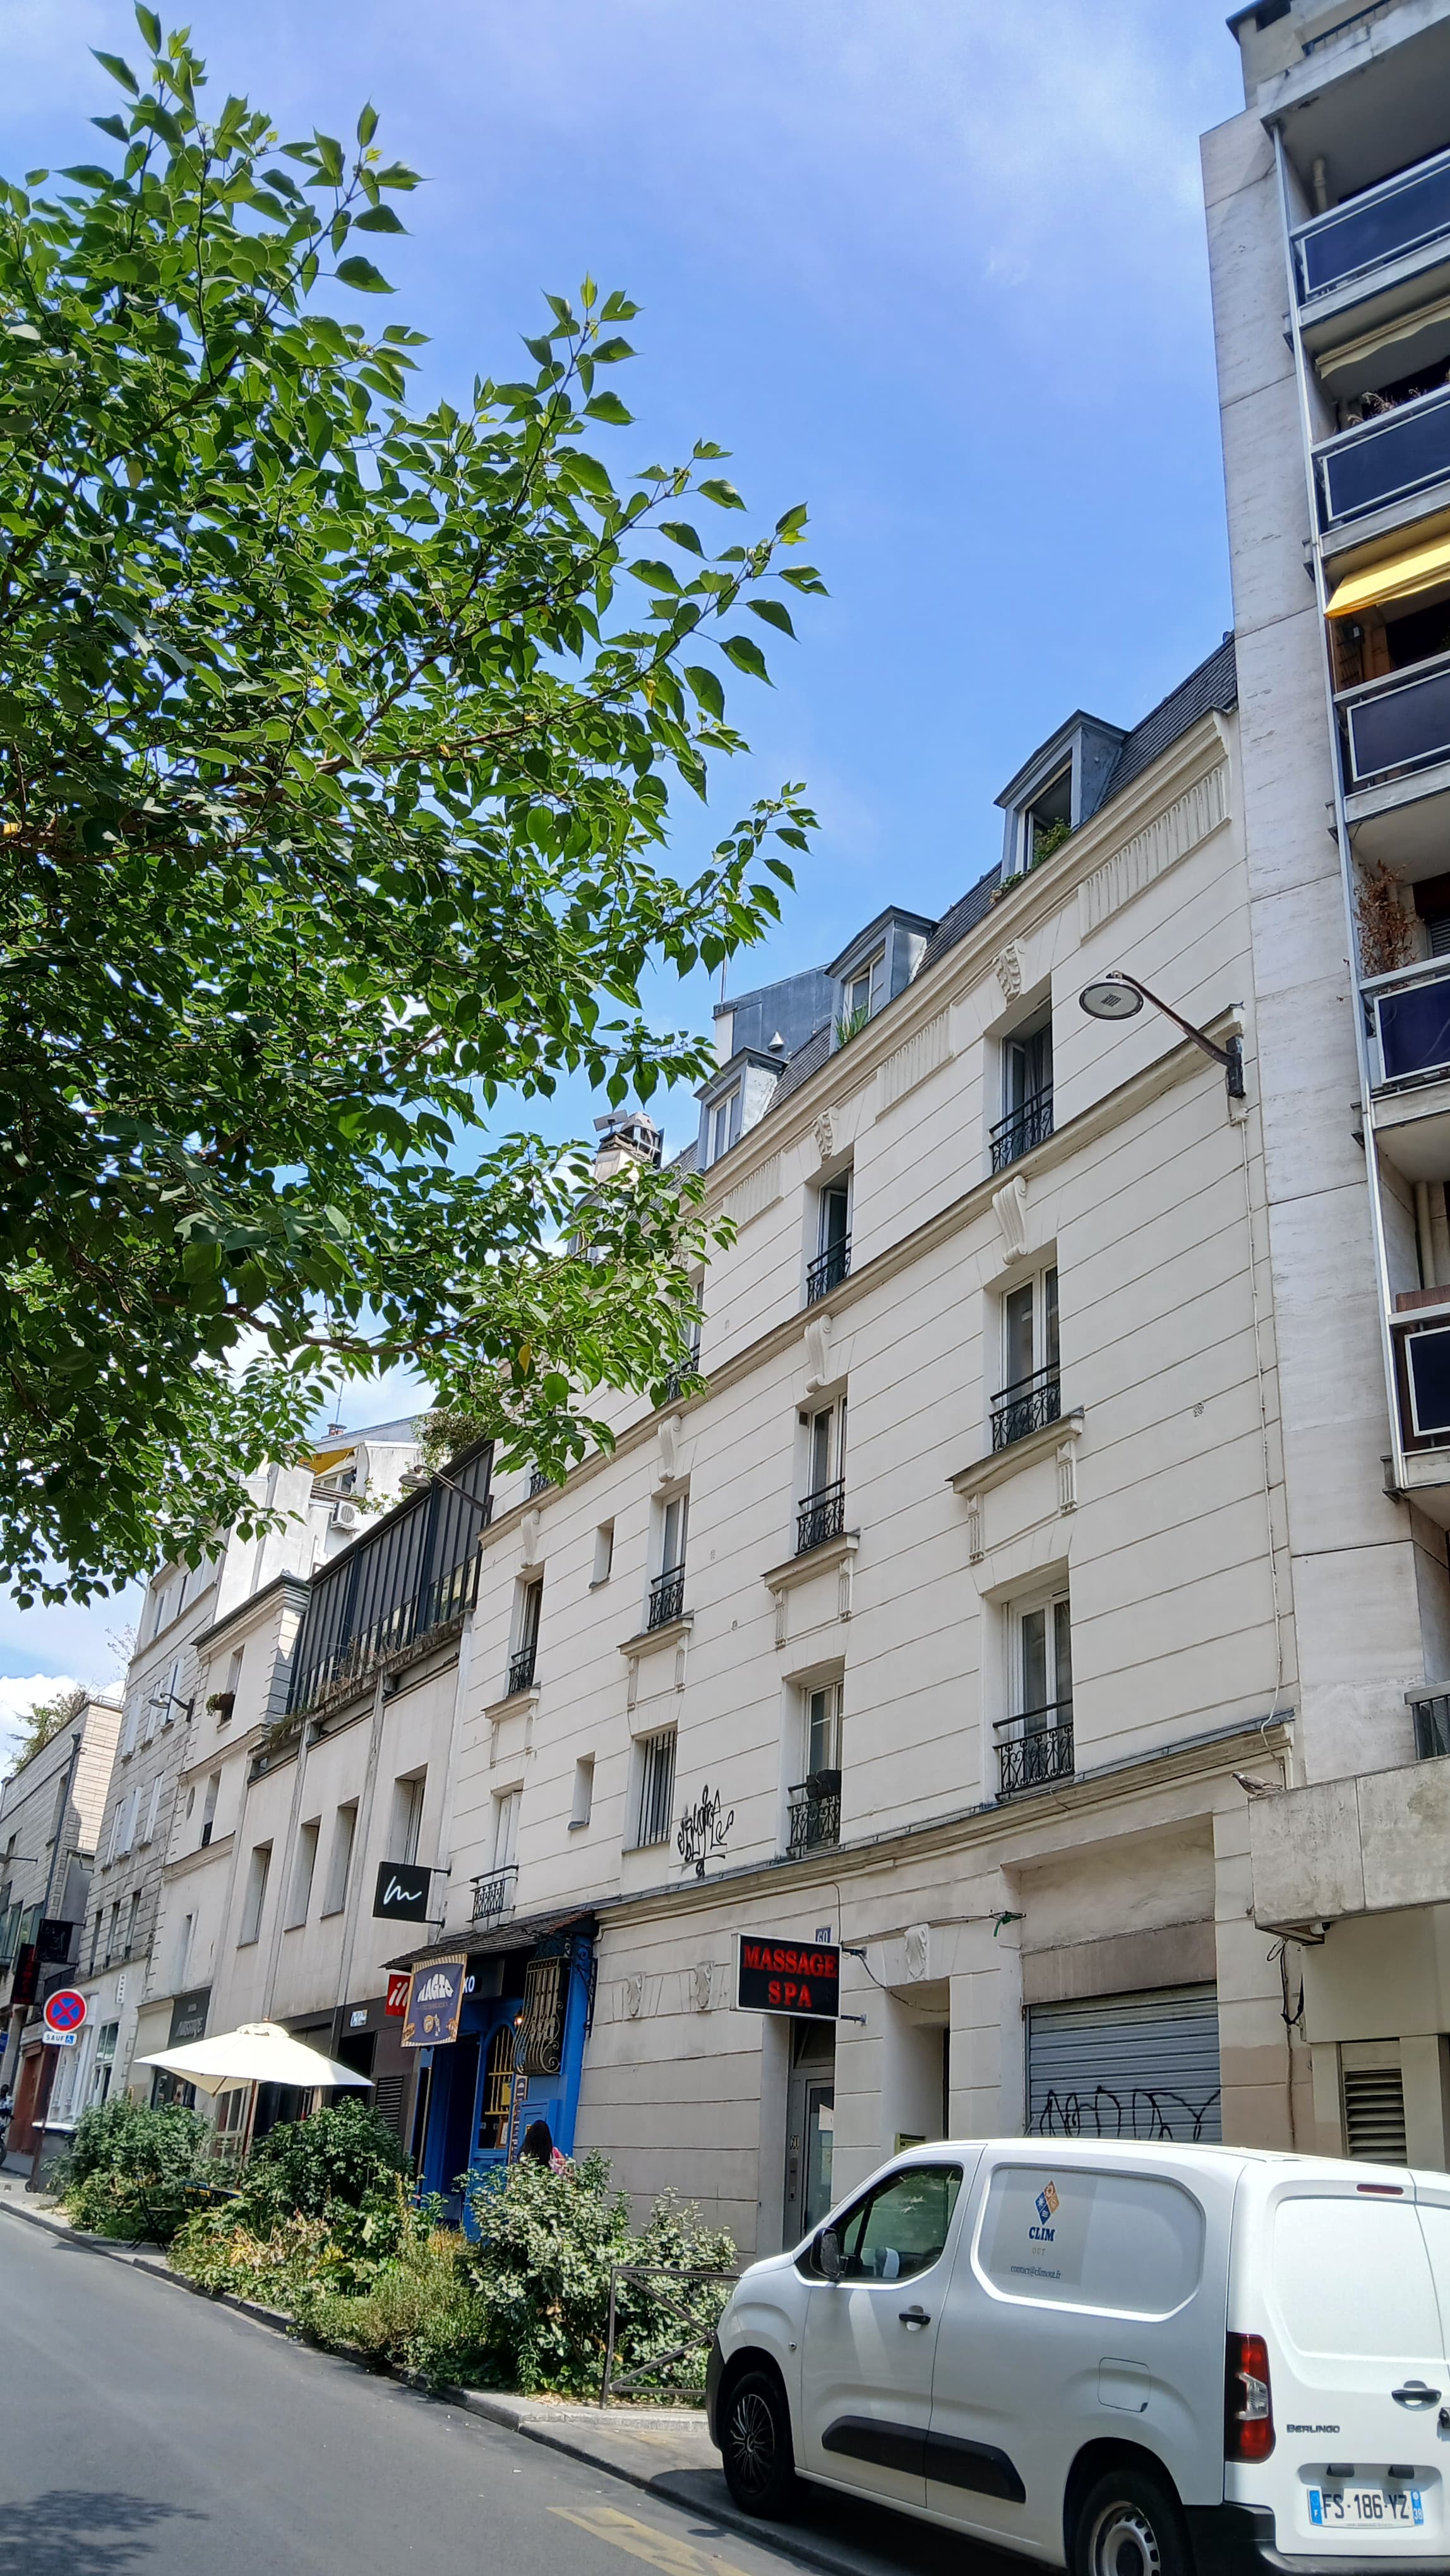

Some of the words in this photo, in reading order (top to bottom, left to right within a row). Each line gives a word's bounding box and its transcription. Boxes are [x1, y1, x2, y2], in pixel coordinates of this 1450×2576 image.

[817, 1931, 829, 1943] 60
[743, 1945, 837, 1978] MASSAGE
[388, 1982, 409, 2007] ill
[769, 1981, 812, 2008] SPA
[791, 2136, 799, 2149] 60
[1029, 2226, 1055, 2241] CLIM
[1413, 2508, 1422, 2520] 38
